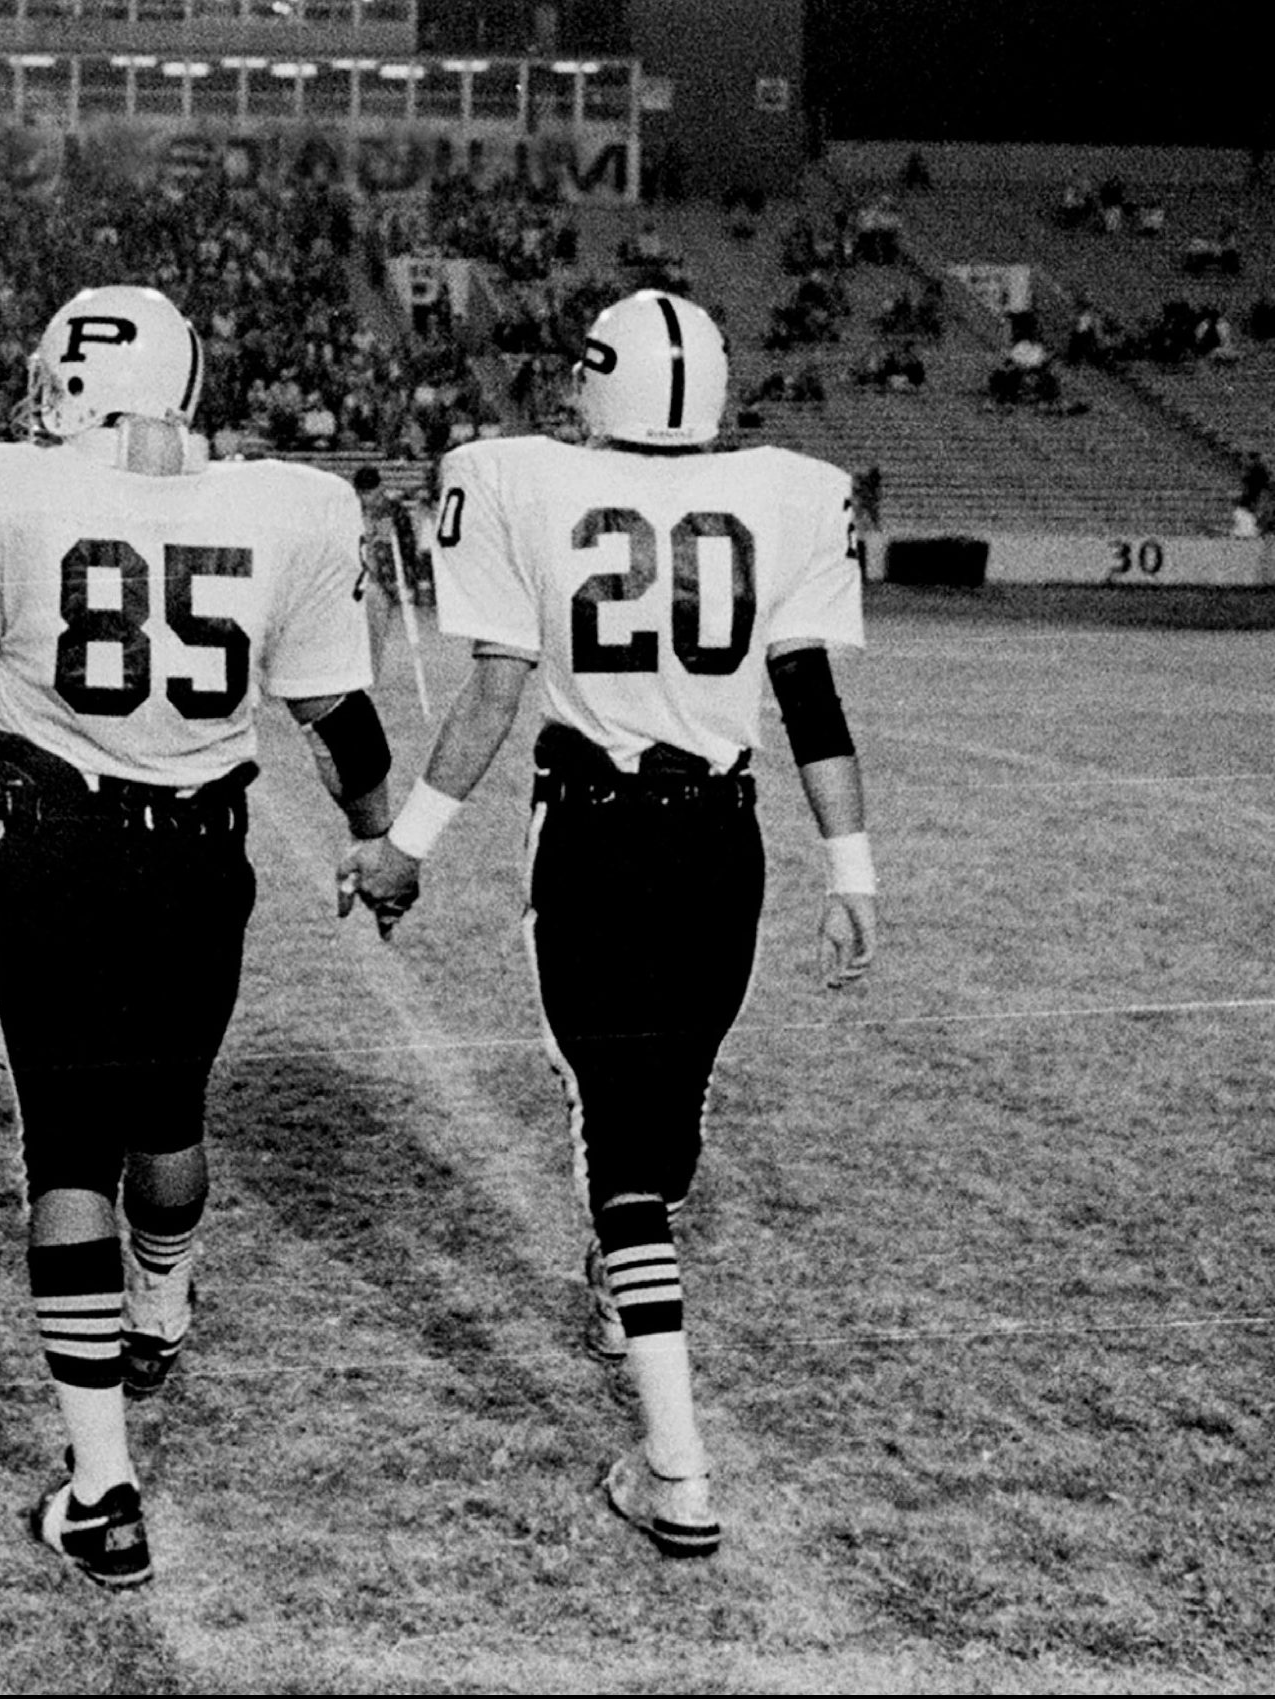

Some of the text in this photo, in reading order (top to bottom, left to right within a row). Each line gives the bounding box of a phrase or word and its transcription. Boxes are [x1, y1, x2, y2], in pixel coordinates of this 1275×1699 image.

[59, 315, 138, 363] P
[570, 506, 757, 675] 20
[1108, 537, 1164, 577] 30
[53, 538, 253, 720] 85
